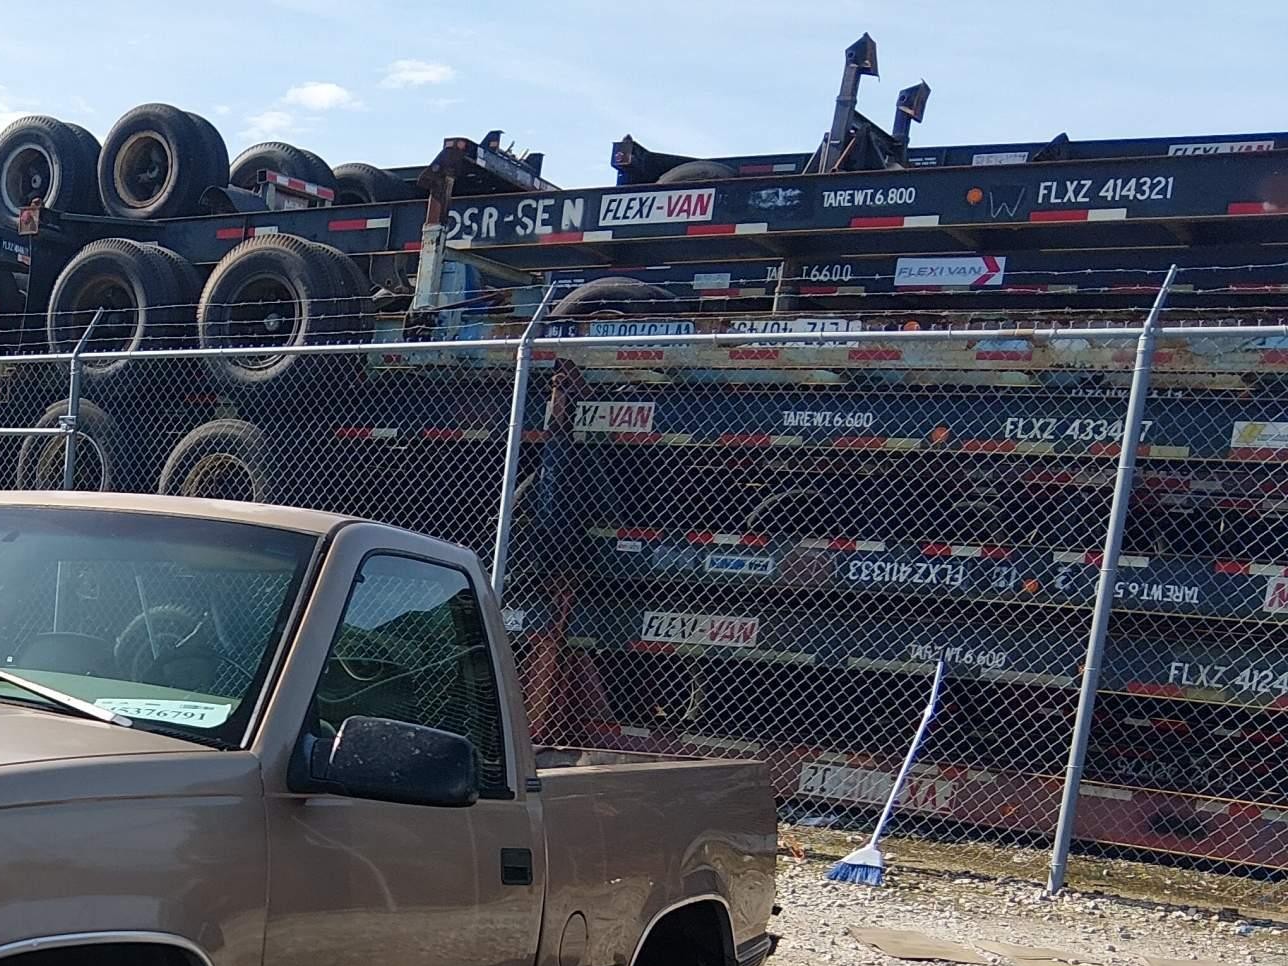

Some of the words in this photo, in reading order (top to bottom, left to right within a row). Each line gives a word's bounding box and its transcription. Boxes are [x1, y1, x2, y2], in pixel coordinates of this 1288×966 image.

[1038, 180, 1093, 204] FLXZ
[1099, 177, 1174, 200] 414321
[602, 193, 712, 222] FLEXI-VAN
[1004, 417, 1058, 440] FLXZ
[644, 616, 756, 644] FLEXI-VAN
[1168, 661, 1227, 688] FLXZ
